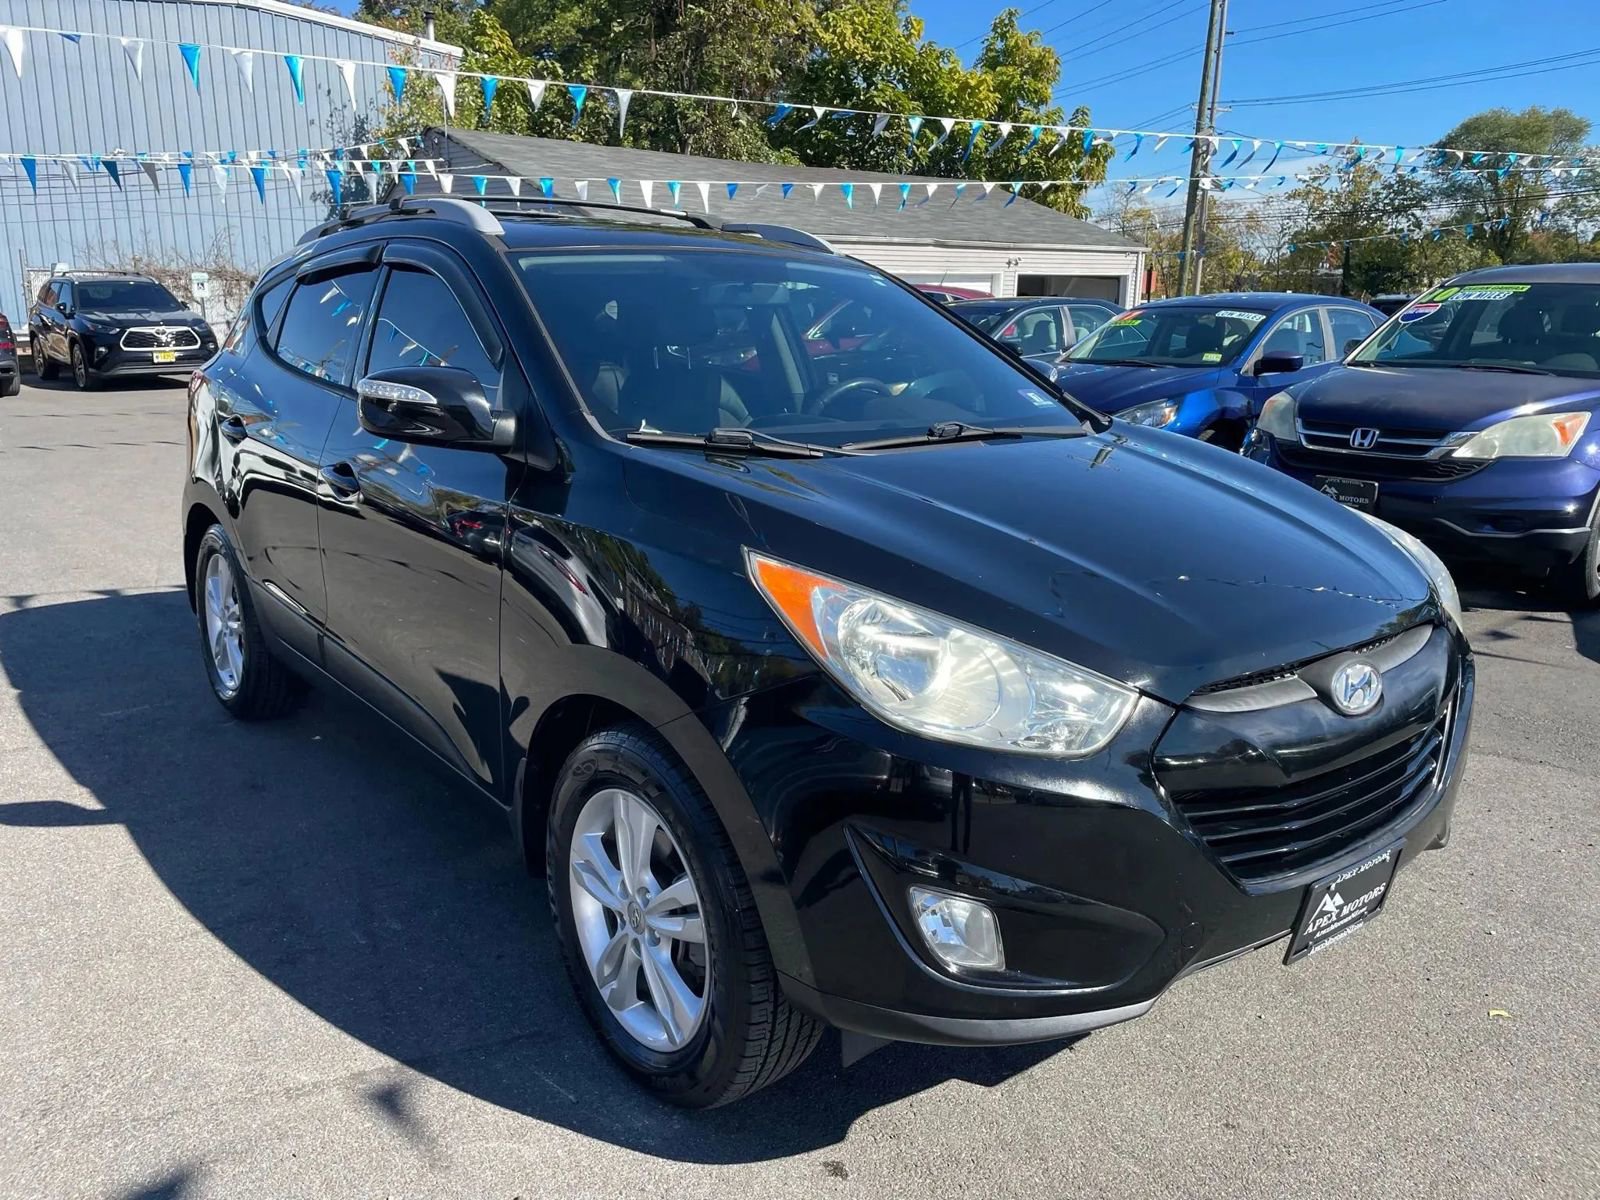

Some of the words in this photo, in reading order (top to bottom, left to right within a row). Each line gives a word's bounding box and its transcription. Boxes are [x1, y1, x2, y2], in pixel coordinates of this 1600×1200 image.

[1339, 495, 1369, 504] MOTORS
[1303, 910, 1340, 936] APEX
[1340, 882, 1386, 917] MOTORS
